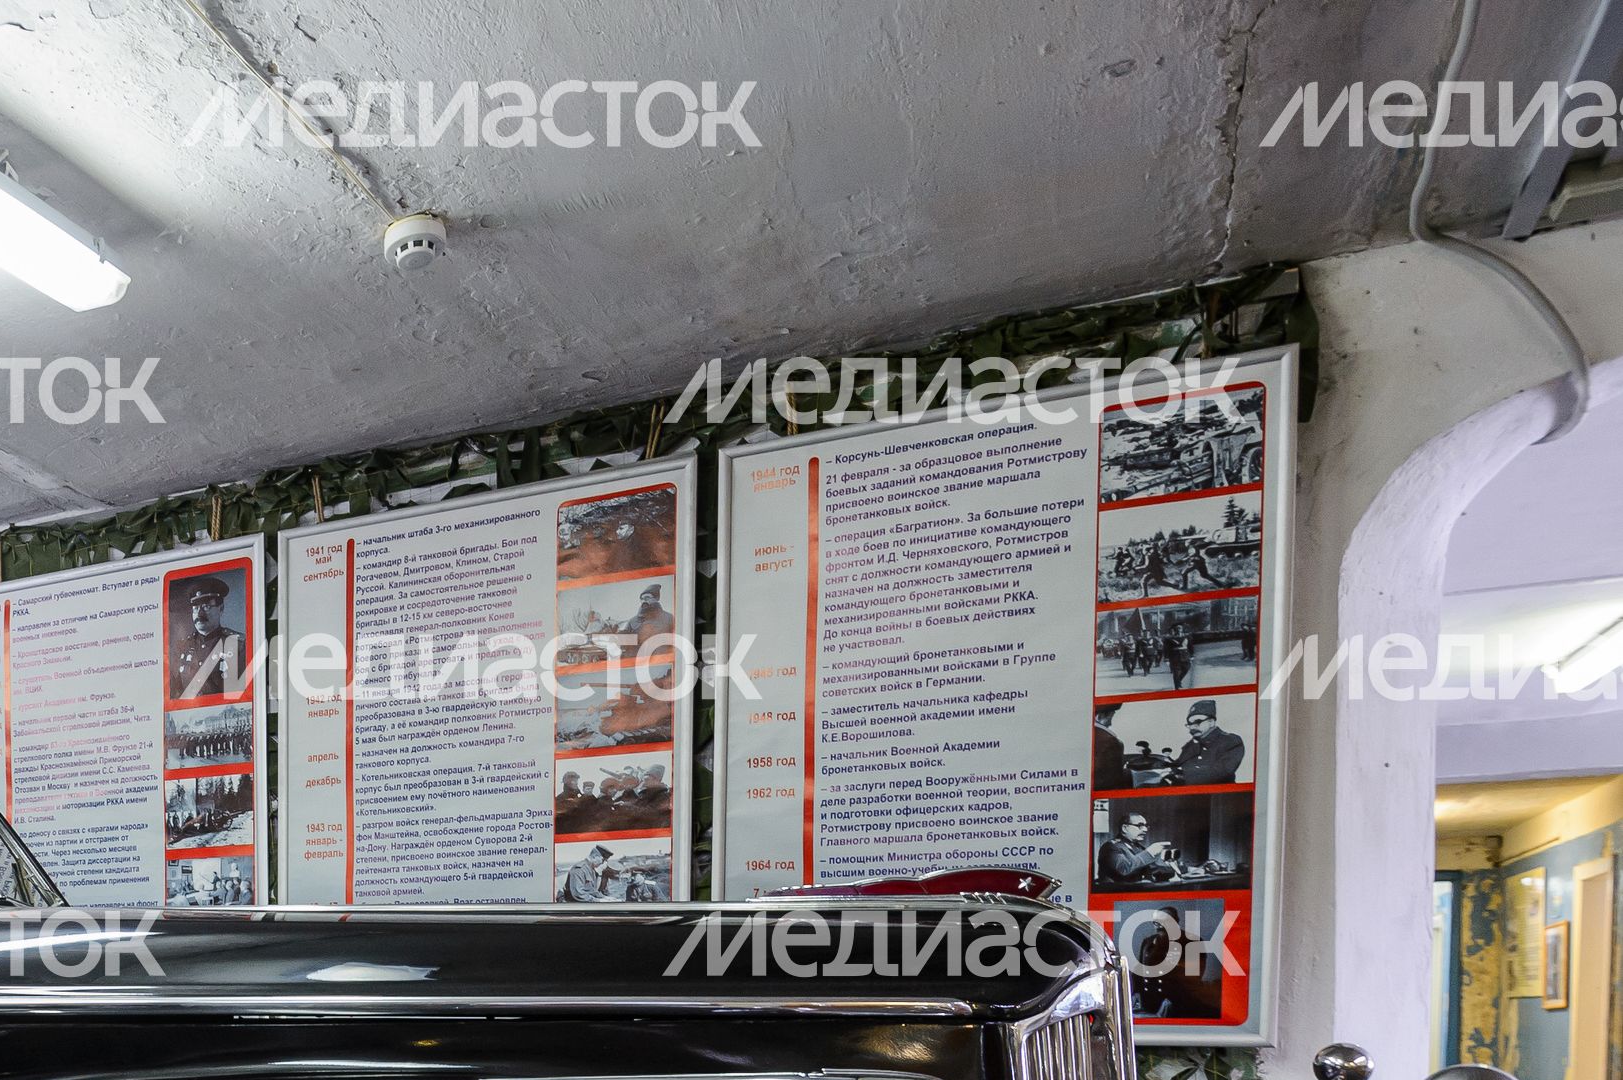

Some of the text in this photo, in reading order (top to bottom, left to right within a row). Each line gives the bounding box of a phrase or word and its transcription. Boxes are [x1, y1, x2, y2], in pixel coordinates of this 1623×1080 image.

[825, 448, 1087, 498] боевых заданий командования Ротмистрову
[825, 470, 1040, 513] присвоено воинское звание маршала
[825, 498, 950, 527] бронетанковых войск.
[876, 551, 898, 564] И.Д.
[902, 540, 991, 560] Черняховского,
[995, 529, 1068, 547] Ротмистров
[851, 573, 857, 581] с
[860, 564, 921, 582] должности
[924, 551, 1012, 571] командующего
[1015, 543, 1060, 560] армией
[1063, 544, 1071, 552] и
[824, 563, 1032, 599] назначен на должность заместителя
[822, 606, 1035, 641] До конца войны в боевых действиях
[822, 653, 1056, 684] механизированными войсками в Группе
[821, 674, 985, 698] советских войск в Германии.
[821, 705, 1015, 729] Высшей военной академии имени
[821, 728, 914, 743] К.Е.Ворошилова.
[746, 756, 796, 768] 1958 год
[746, 786, 795, 799] 1962 год
[819, 782, 1085, 808] деле разработки военной теории, воспитания
[820, 801, 1012, 820] и подготовки офицерских кадров,
[820, 812, 1058, 833] Ротмистрову присвоено воинское звание
[820, 825, 1058, 846] Главного маршала бронетанковых войск.
[745, 859, 794, 871] 1964 год
